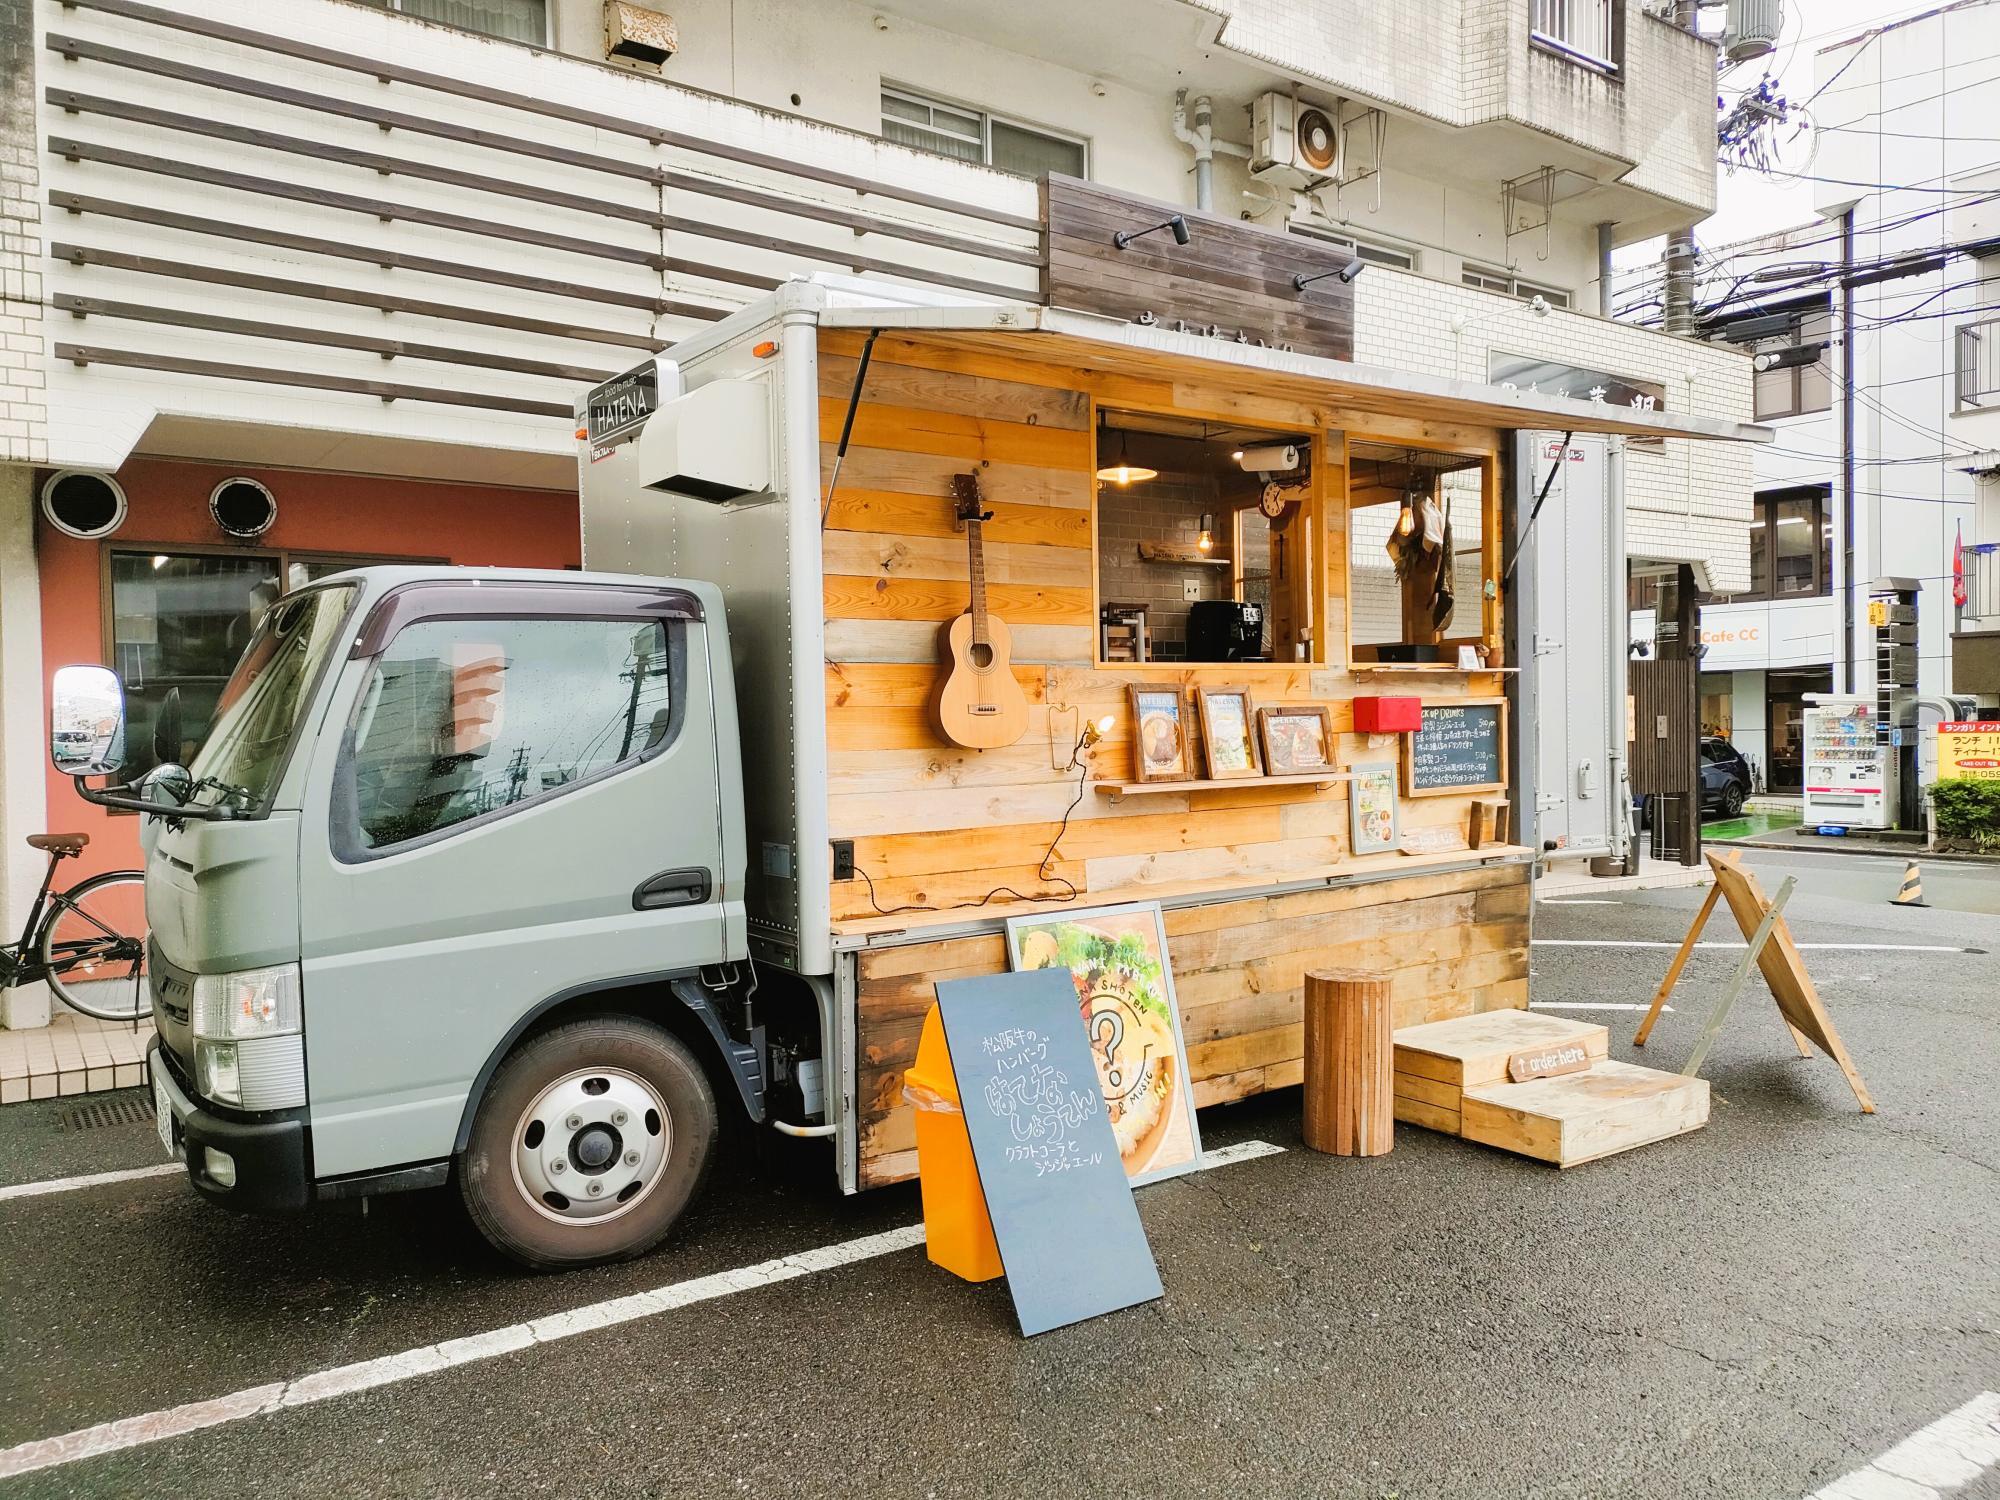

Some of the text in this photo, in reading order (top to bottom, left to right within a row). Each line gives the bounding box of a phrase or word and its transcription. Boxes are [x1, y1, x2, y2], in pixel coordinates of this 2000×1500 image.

[597, 386, 648, 433] HATENA
[1701, 628, 1759, 643] Cafe CC
[1945, 724, 1976, 732] ランガリ
[1952, 736, 1981, 745] ランチ
[982, 1027, 1037, 1056] 松阪牛の
[997, 1035, 1050, 1074] ハンバーグ
[1557, 1048, 1586, 1065] here
[984, 1063, 1069, 1117] はてな
[1129, 1070, 1153, 1105] MUSIC
